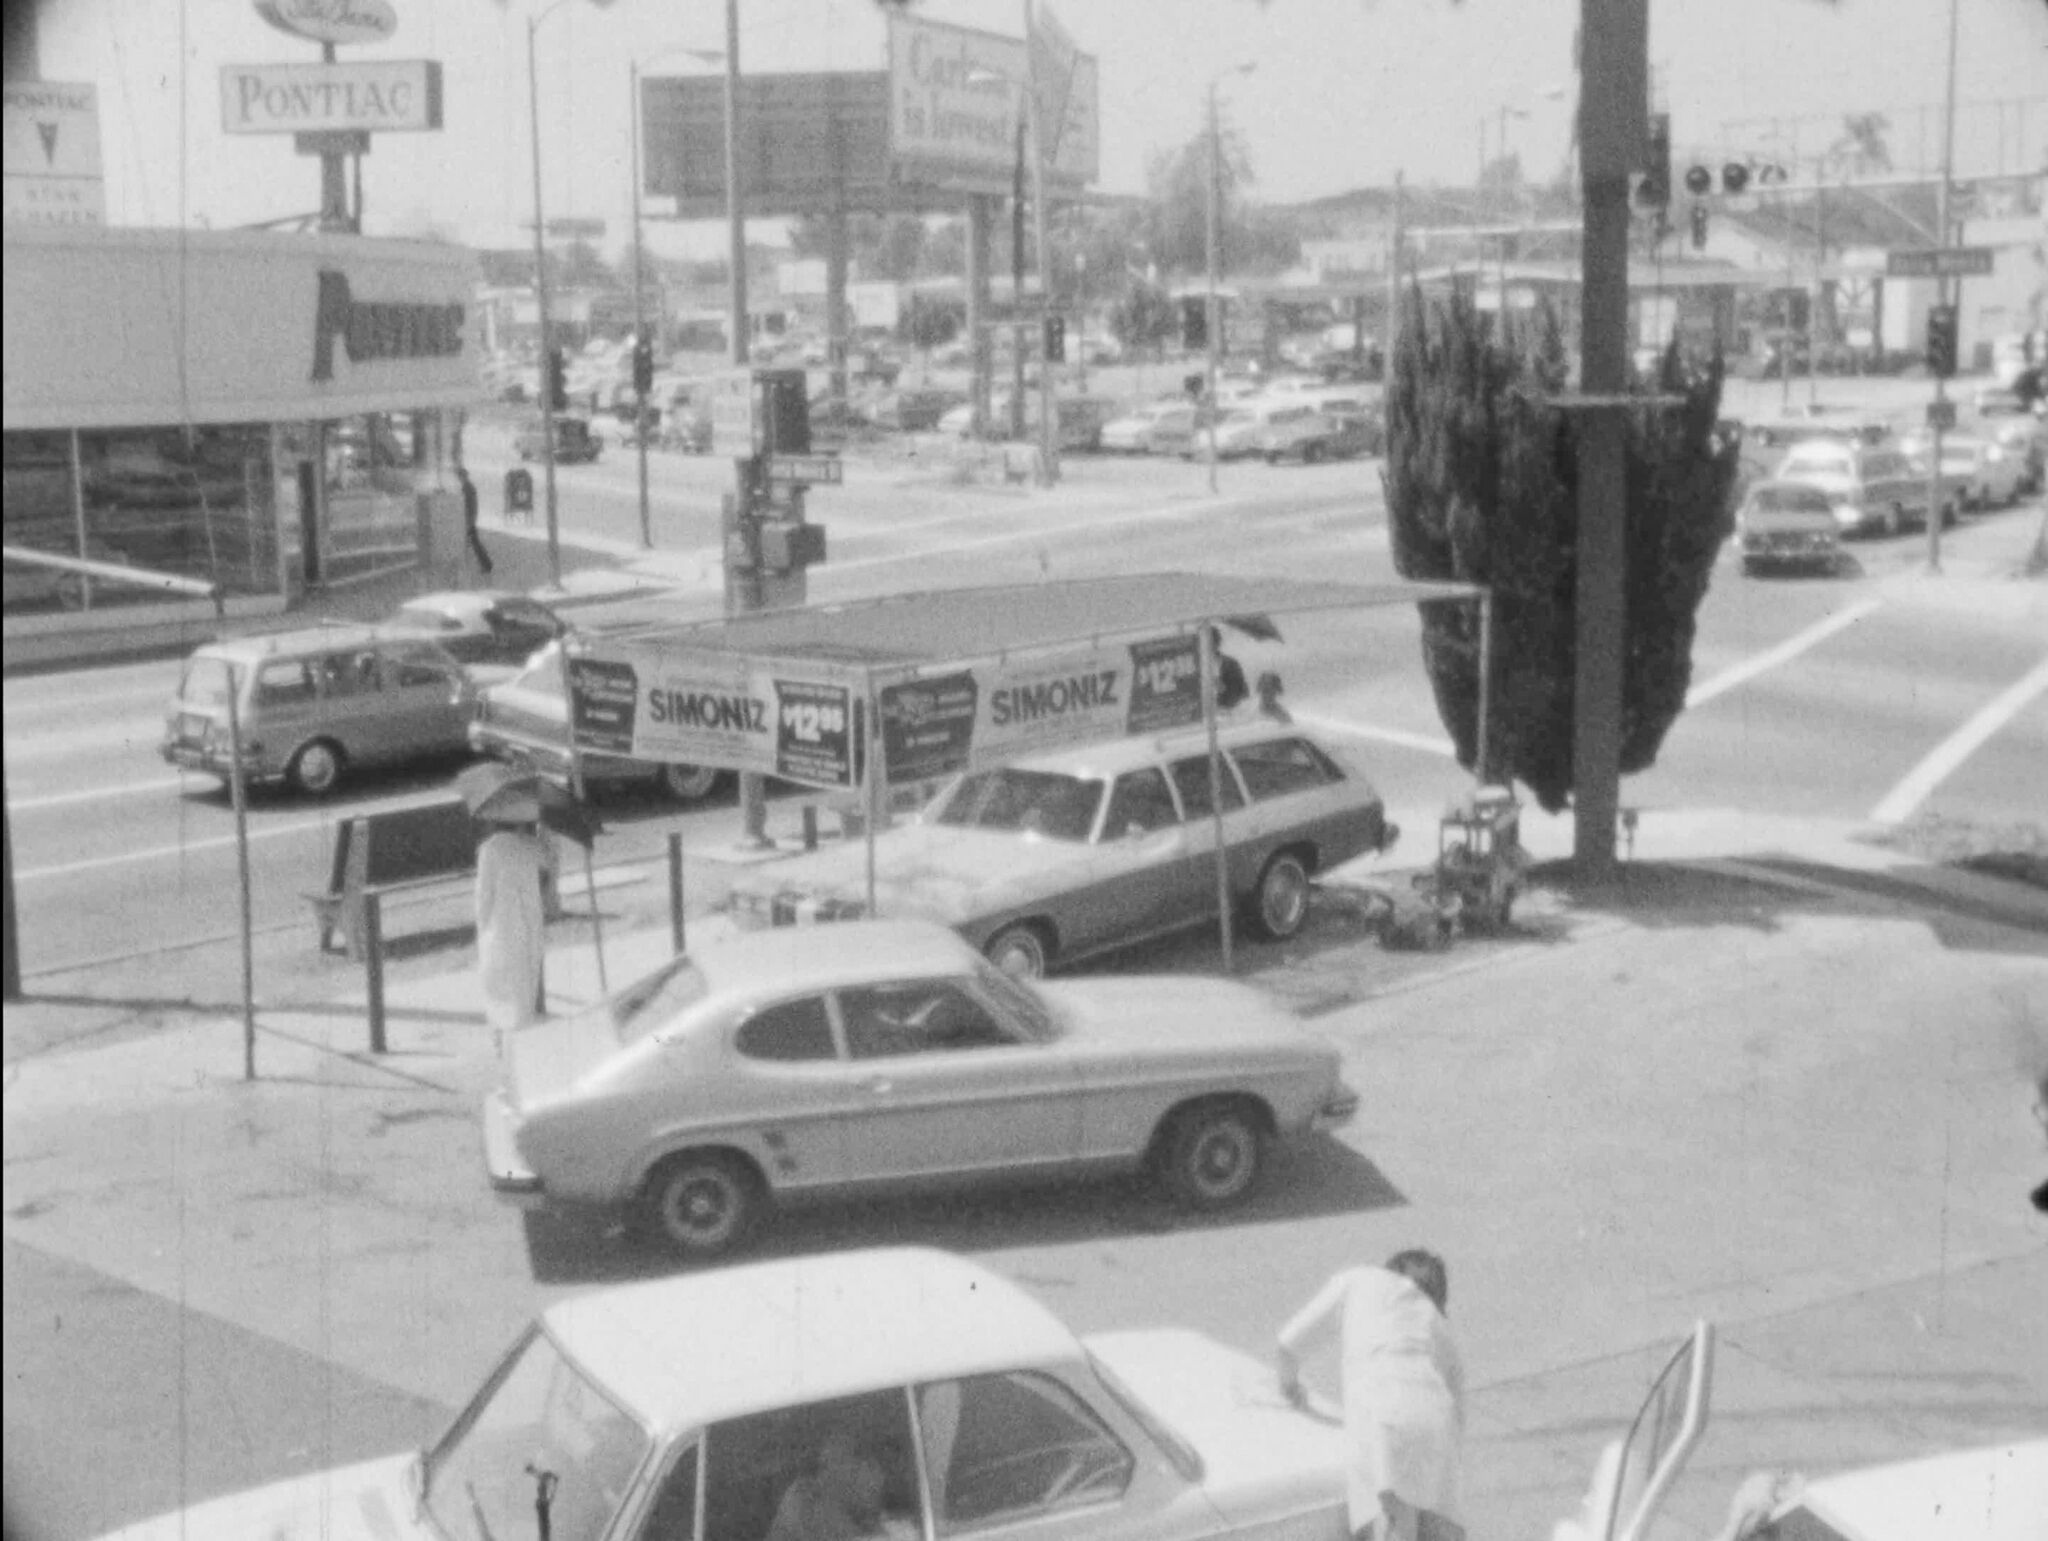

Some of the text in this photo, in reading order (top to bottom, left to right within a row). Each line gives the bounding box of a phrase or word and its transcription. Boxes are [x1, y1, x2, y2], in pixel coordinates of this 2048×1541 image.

[235, 74, 411, 122] PONTIAC
[649, 688, 768, 733] SIMONIZ
[991, 670, 1118, 726] SIMONIZ
